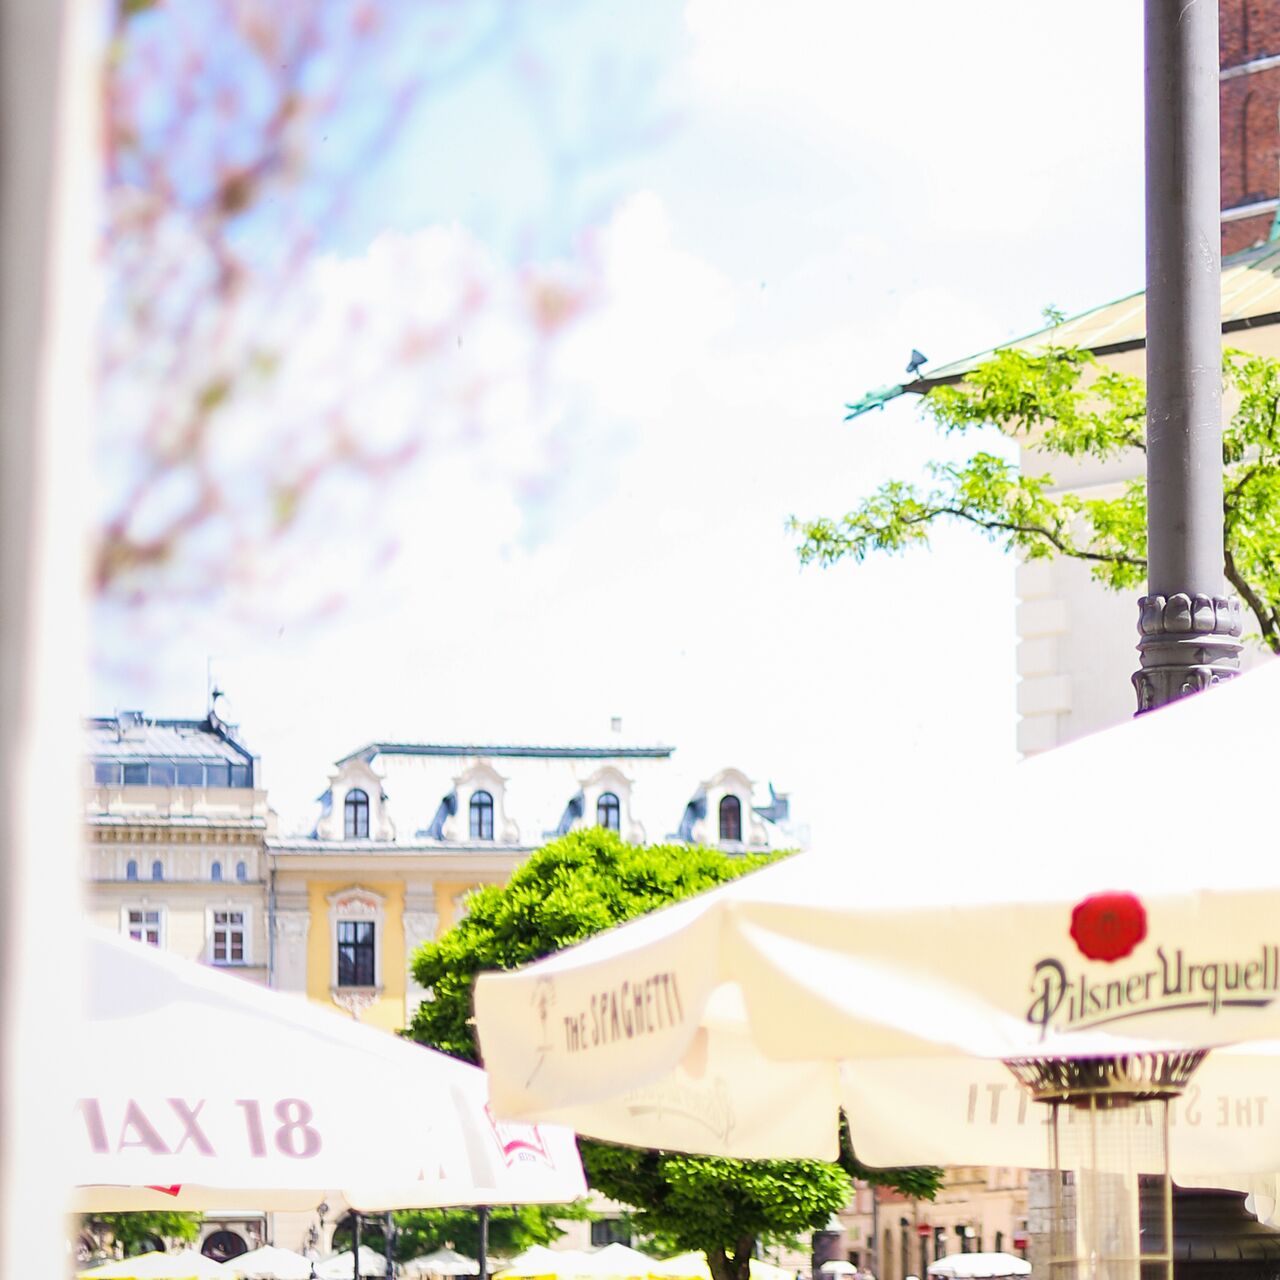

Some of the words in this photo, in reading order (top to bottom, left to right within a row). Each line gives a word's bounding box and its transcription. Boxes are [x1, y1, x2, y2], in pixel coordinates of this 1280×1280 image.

[564, 1013, 588, 1052] THE
[590, 973, 685, 1047] SPAGHETTI
[1026, 958, 1158, 1043] Pilsner
[1157, 944, 1279, 1015] Urquell
[234, 1098, 323, 1159] 18
